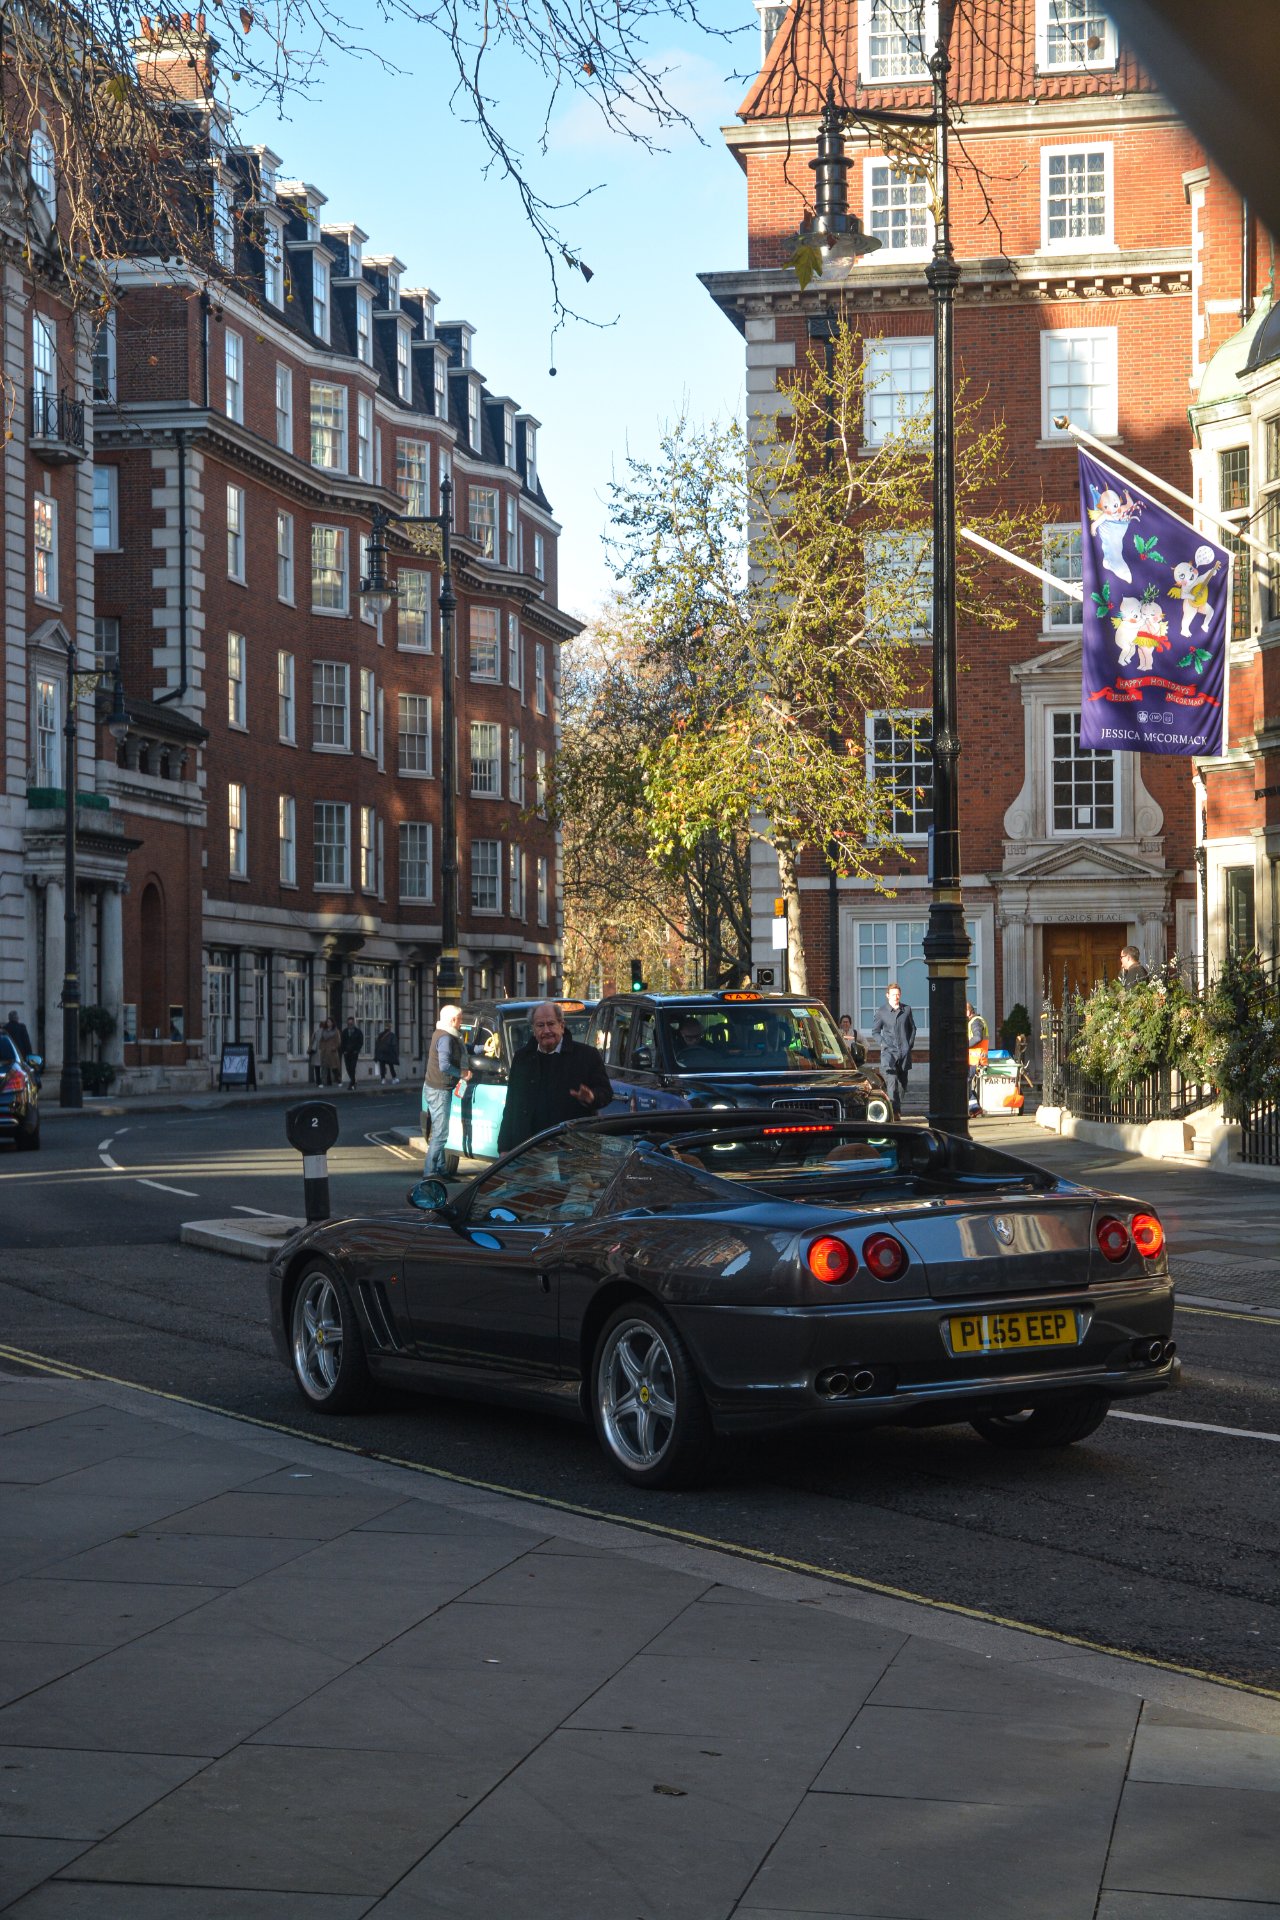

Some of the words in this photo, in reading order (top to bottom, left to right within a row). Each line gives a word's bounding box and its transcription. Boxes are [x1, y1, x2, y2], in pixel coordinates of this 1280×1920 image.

[1119, 679, 1143, 689] HAPPY
[1150, 678, 1191, 695] HOLIDAYS
[1111, 693, 1137, 701] JESSICA
[1101, 728, 1141, 740] JESSICA
[1143, 732, 1208, 746] McCORMACK
[311, 1117, 319, 1127] 2
[960, 1317, 1021, 1346] PL55
[1026, 1314, 1066, 1341] EEP
